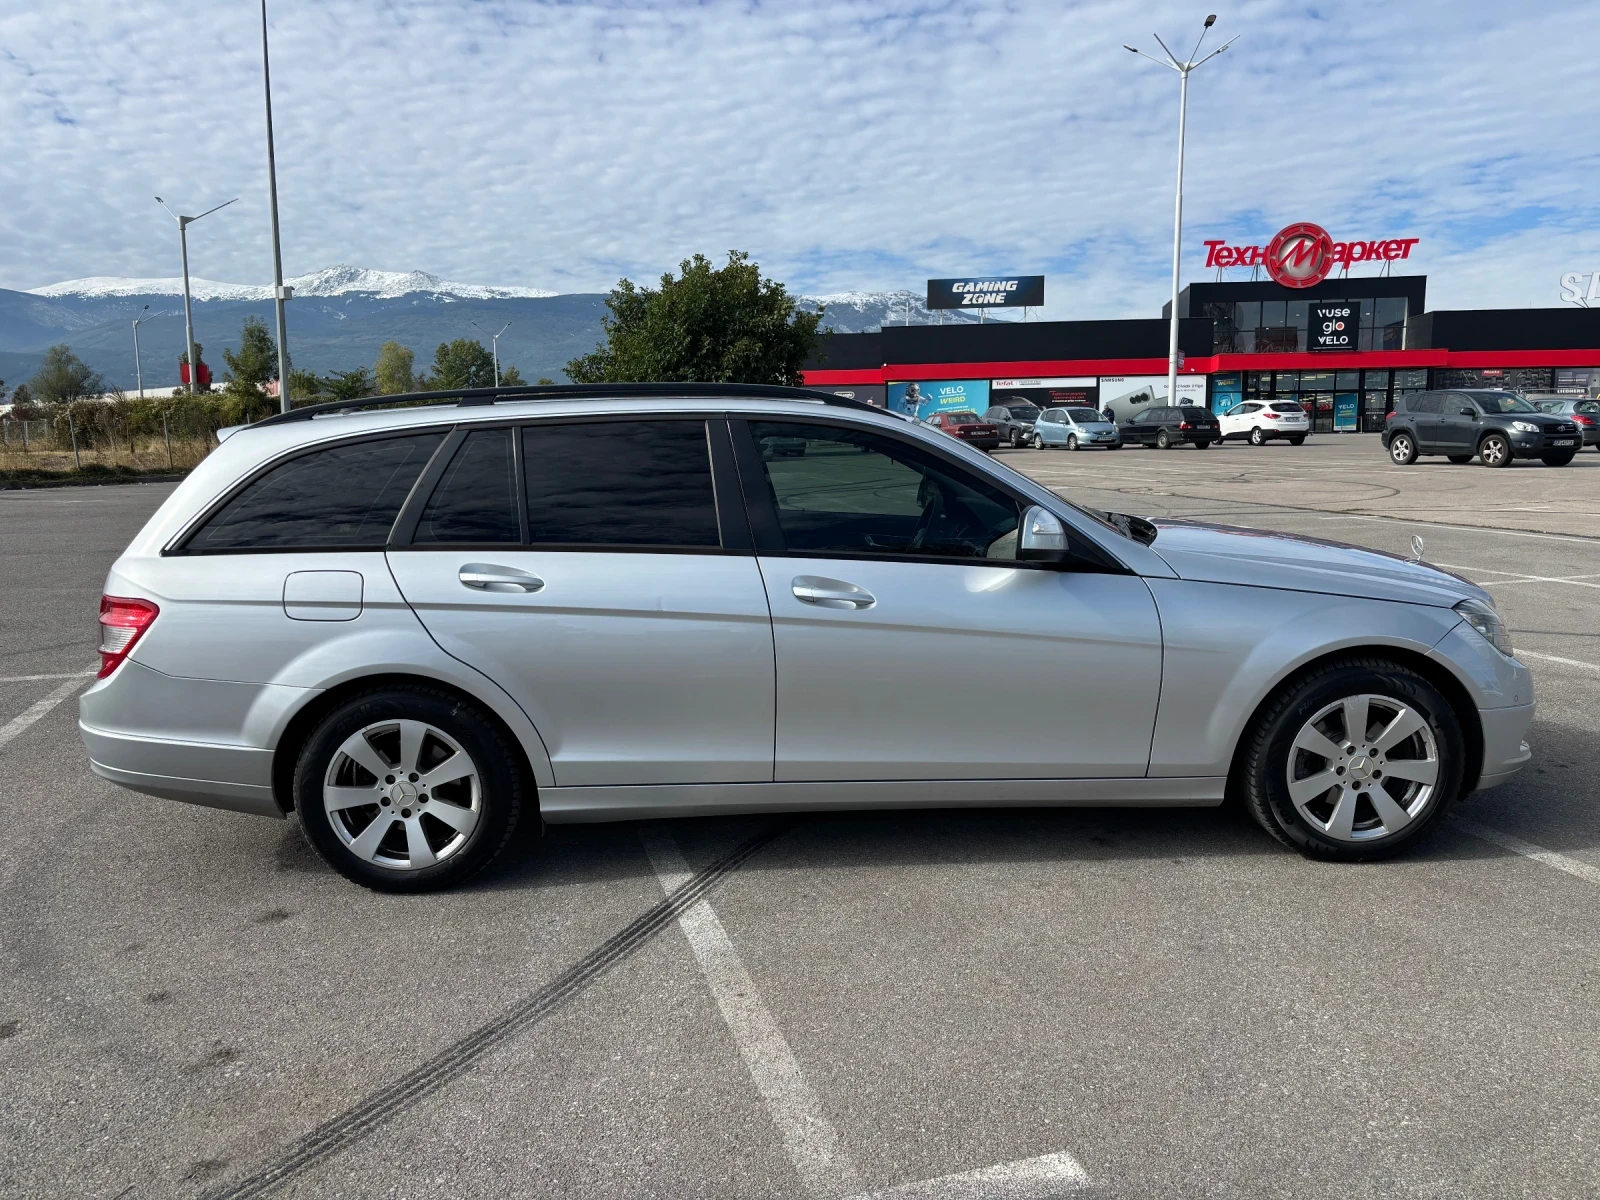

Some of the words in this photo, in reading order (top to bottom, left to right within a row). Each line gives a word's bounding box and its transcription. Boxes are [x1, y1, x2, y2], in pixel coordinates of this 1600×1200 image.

[952, 280, 1019, 293] GAMING
[961, 292, 1007, 305] ZONE
[1322, 318, 1345, 335] glo
[1317, 335, 1349, 345] VELO
[939, 385, 964, 394] VELO
[940, 395, 966, 405] WEIRD
